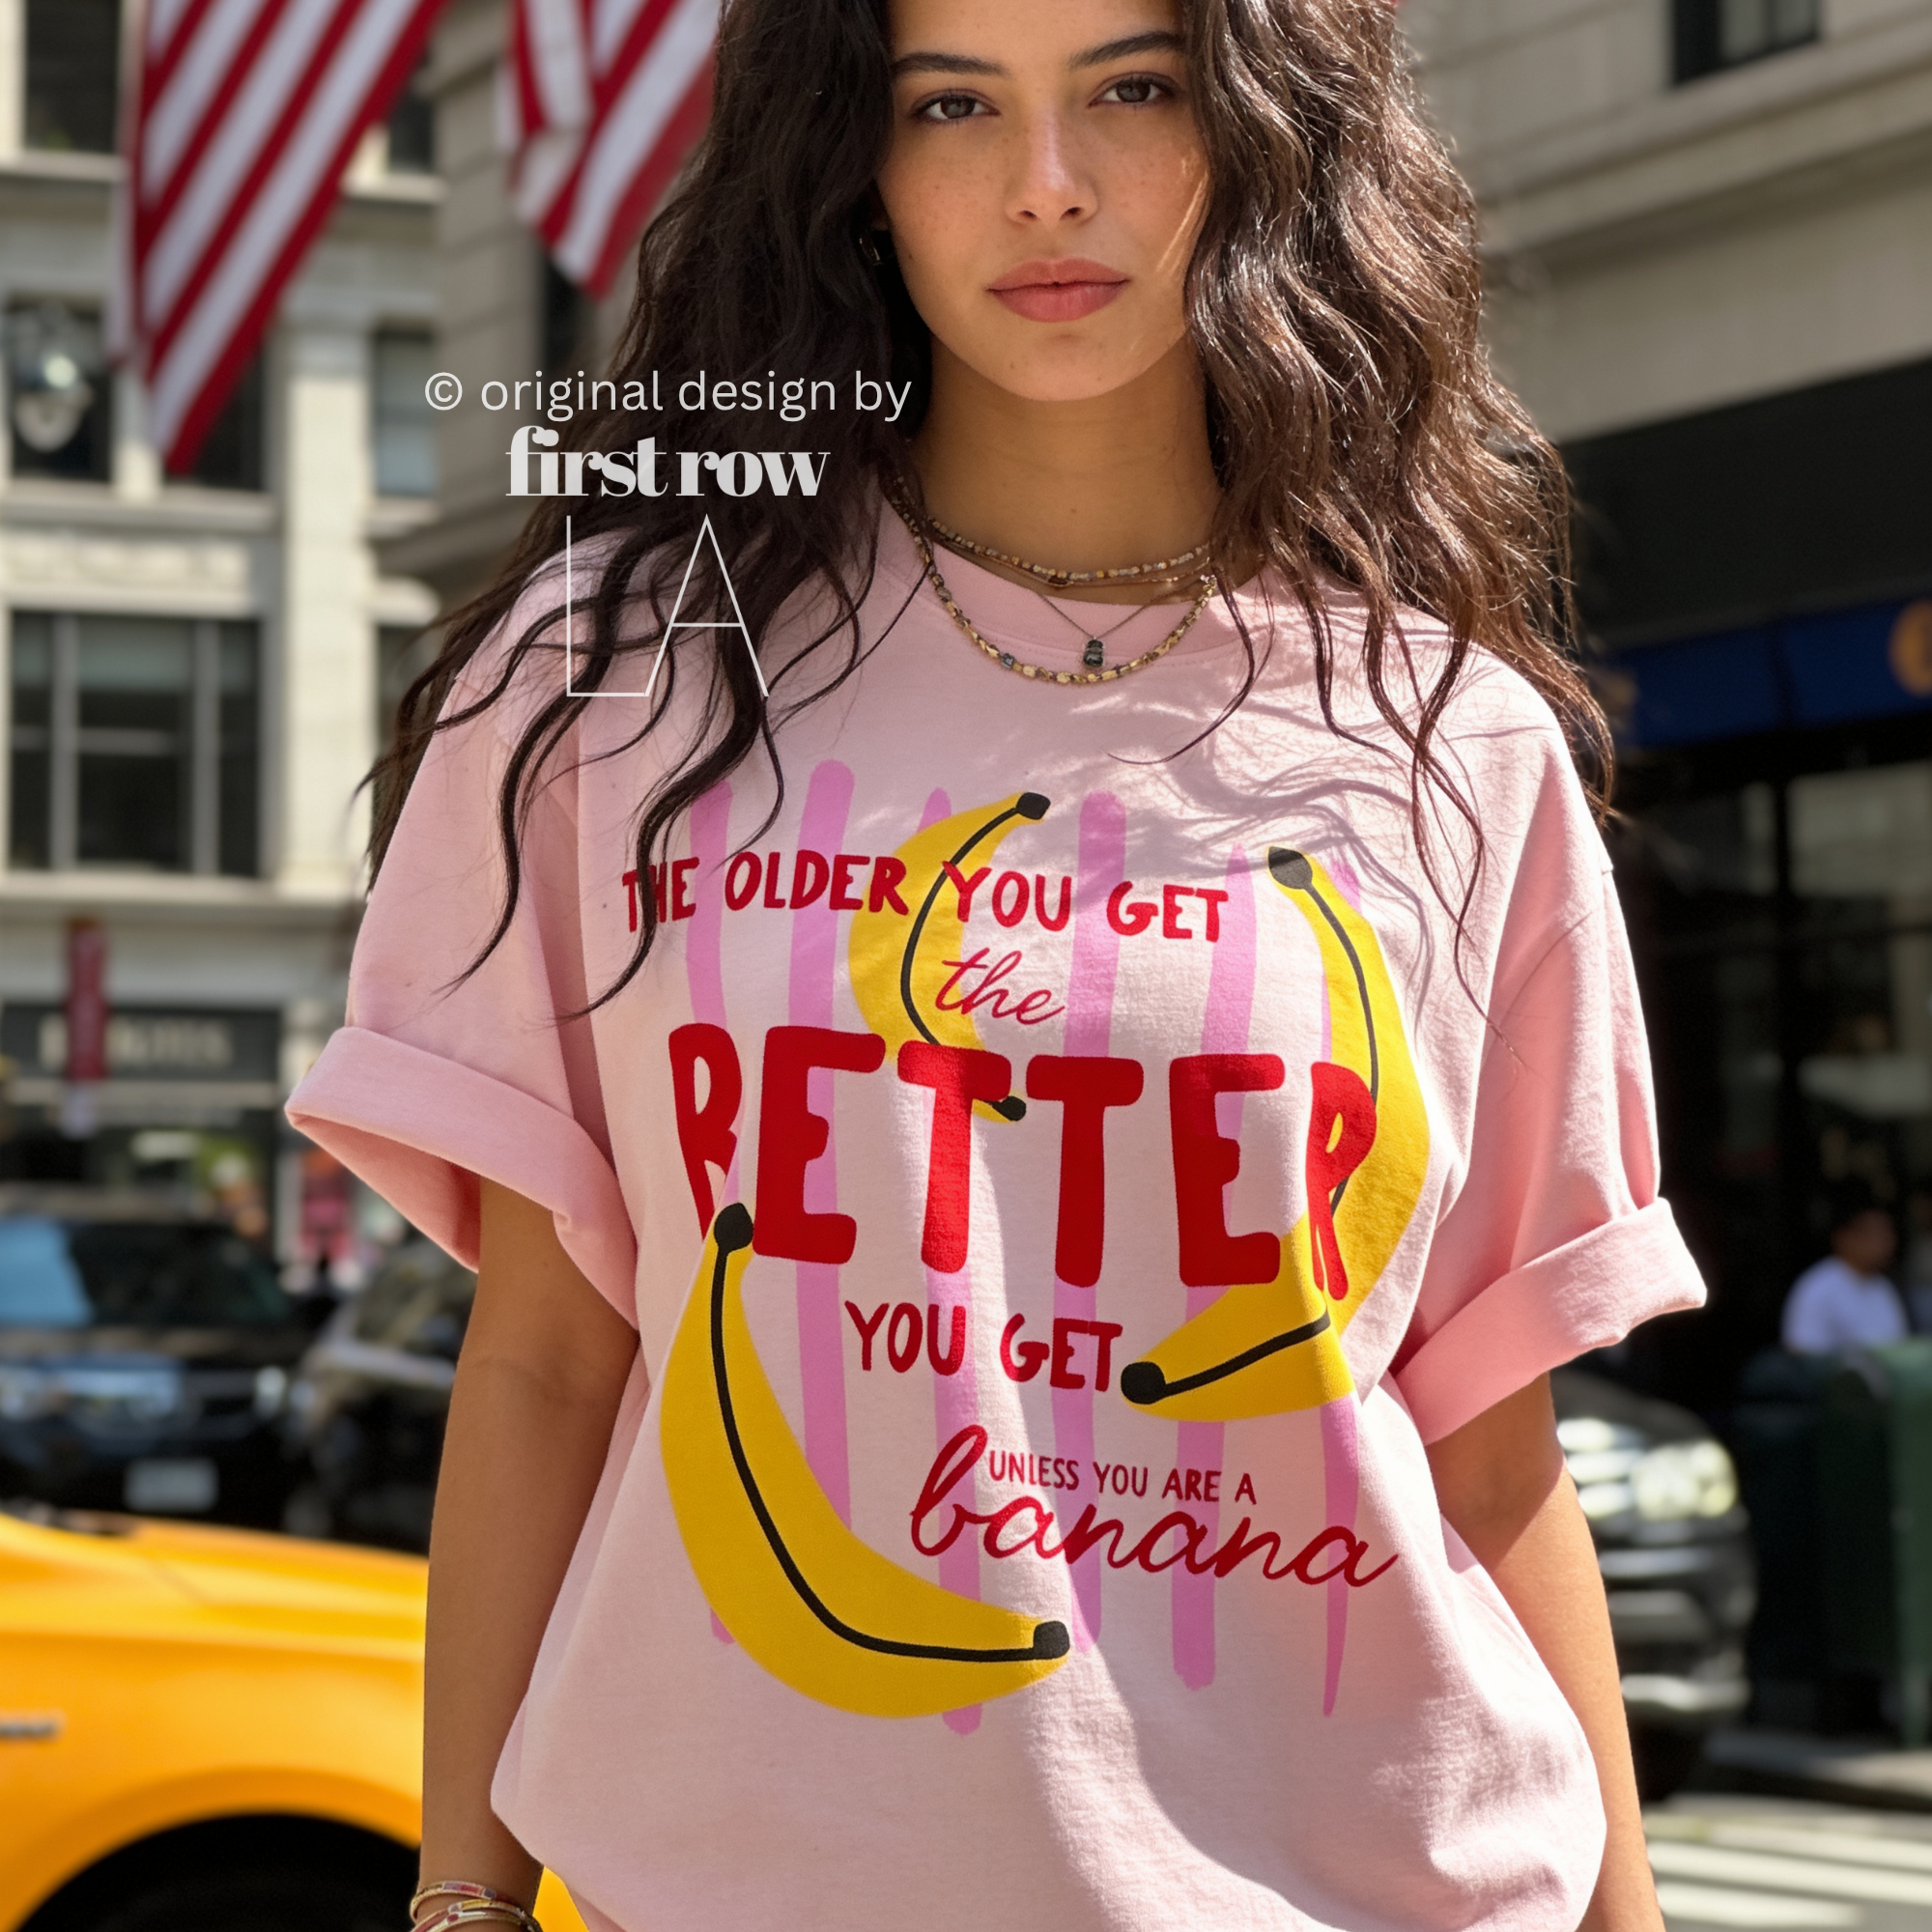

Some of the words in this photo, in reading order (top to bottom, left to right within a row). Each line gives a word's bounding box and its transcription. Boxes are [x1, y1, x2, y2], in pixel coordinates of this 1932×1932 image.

[621, 856, 700, 932] THE
[724, 848, 910, 917] OLDER
[942, 860, 1072, 933] YOU
[1106, 880, 1229, 943] GET
[934, 947, 1065, 1026] the
[668, 1022, 1378, 1301] BETTER
[844, 1300, 967, 1378] YOU
[999, 1313, 1123, 1392] GET
[910, 1424, 1399, 1588] banana
[988, 1450, 1080, 1492] UNLESS
[1092, 1461, 1149, 1498] YOU
[1161, 1467, 1222, 1503] ARE
[1235, 1472, 1258, 1505] A
